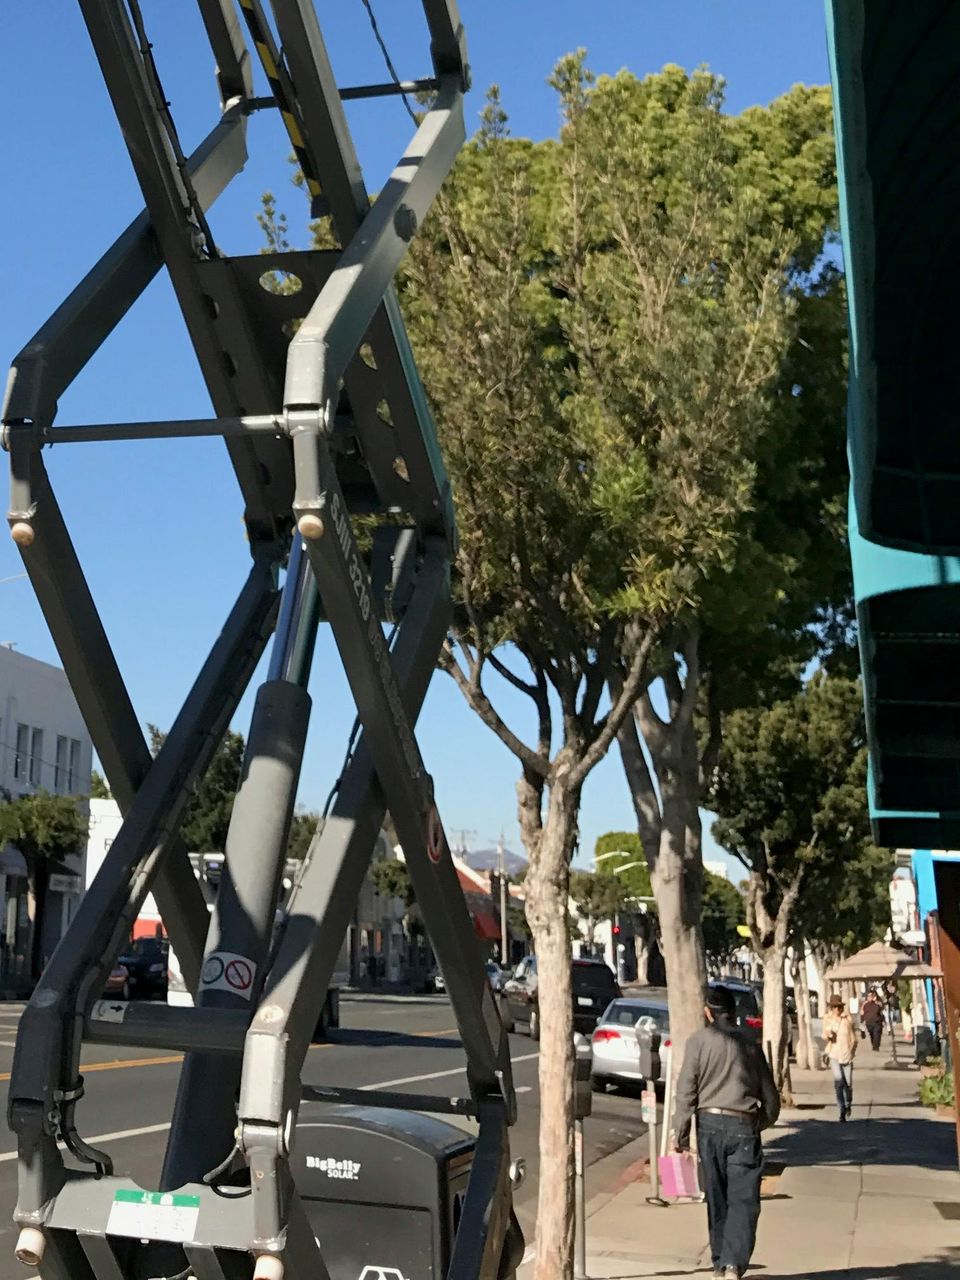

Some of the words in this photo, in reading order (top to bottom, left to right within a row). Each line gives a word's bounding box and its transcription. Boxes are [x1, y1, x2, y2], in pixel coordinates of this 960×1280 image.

[349, 553, 370, 622] 3219
[306, 1156, 361, 1174] BigBelly
[327, 1169, 354, 1180] SOLAR
